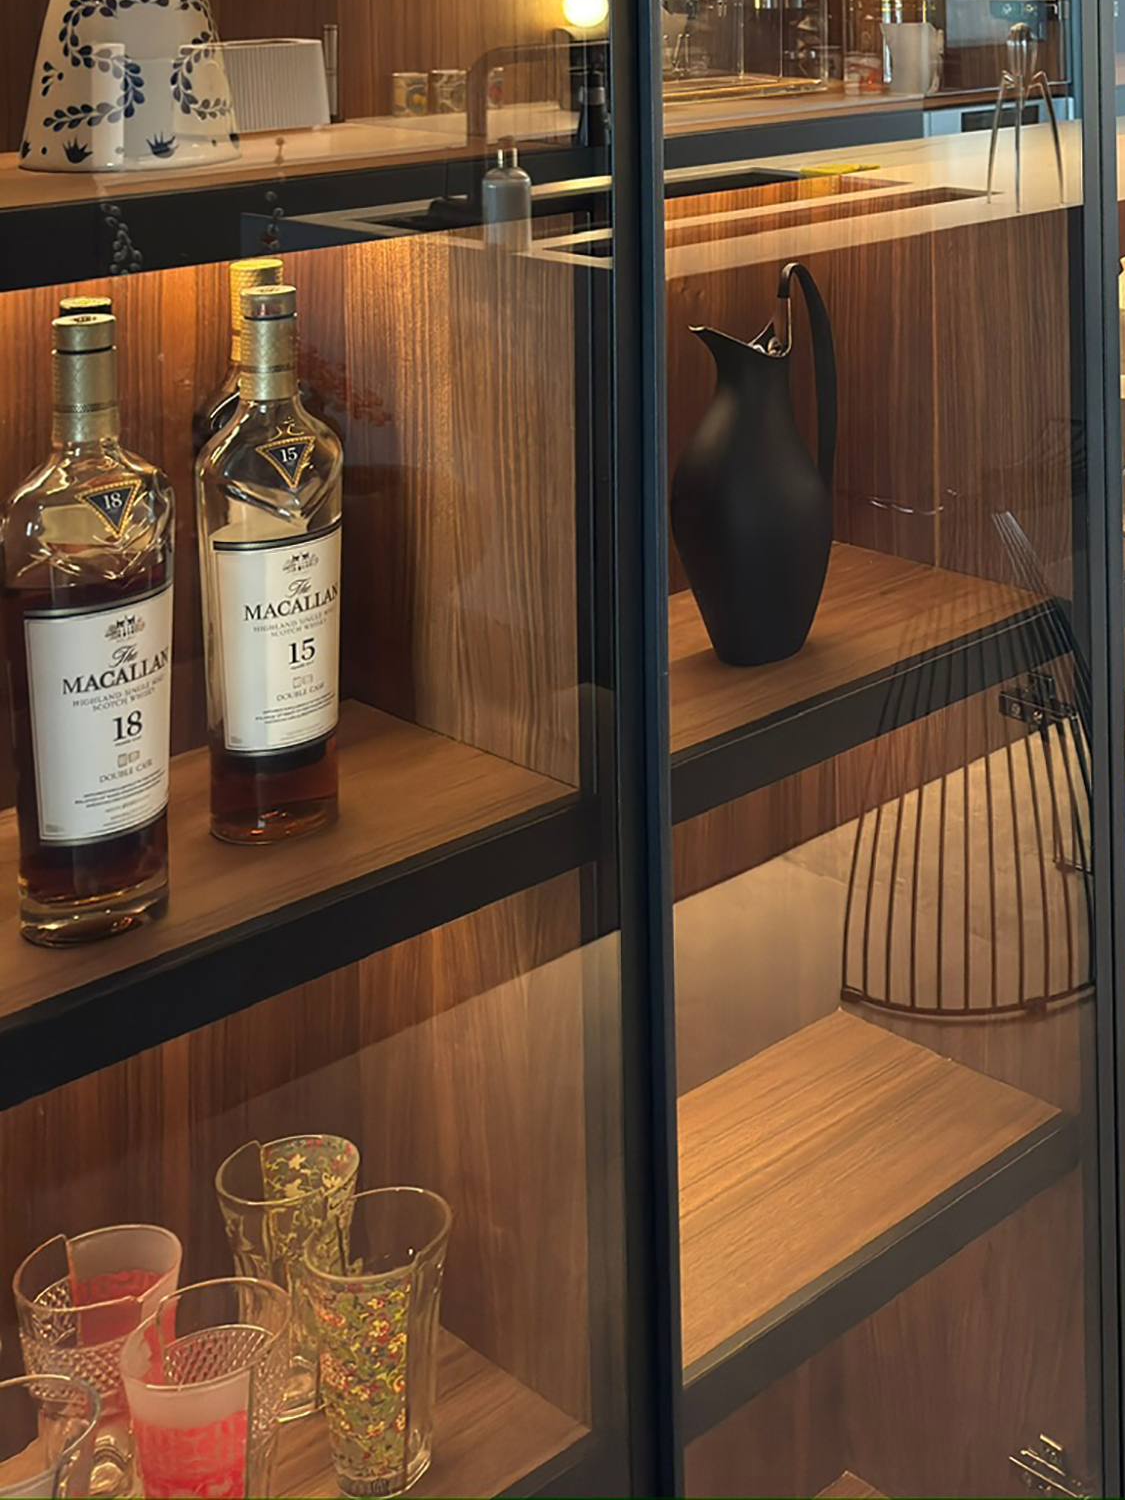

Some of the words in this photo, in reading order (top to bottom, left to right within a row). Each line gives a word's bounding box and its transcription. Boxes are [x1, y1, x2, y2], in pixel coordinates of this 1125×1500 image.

[281, 447, 298, 462] 15
[103, 492, 122, 510] 18
[286, 577, 312, 598] The
[244, 582, 339, 621] MACALLAN
[109, 643, 139, 668] The
[288, 637, 316, 665] 15
[62, 646, 169, 694] MACALLAN
[113, 710, 143, 741] 18
